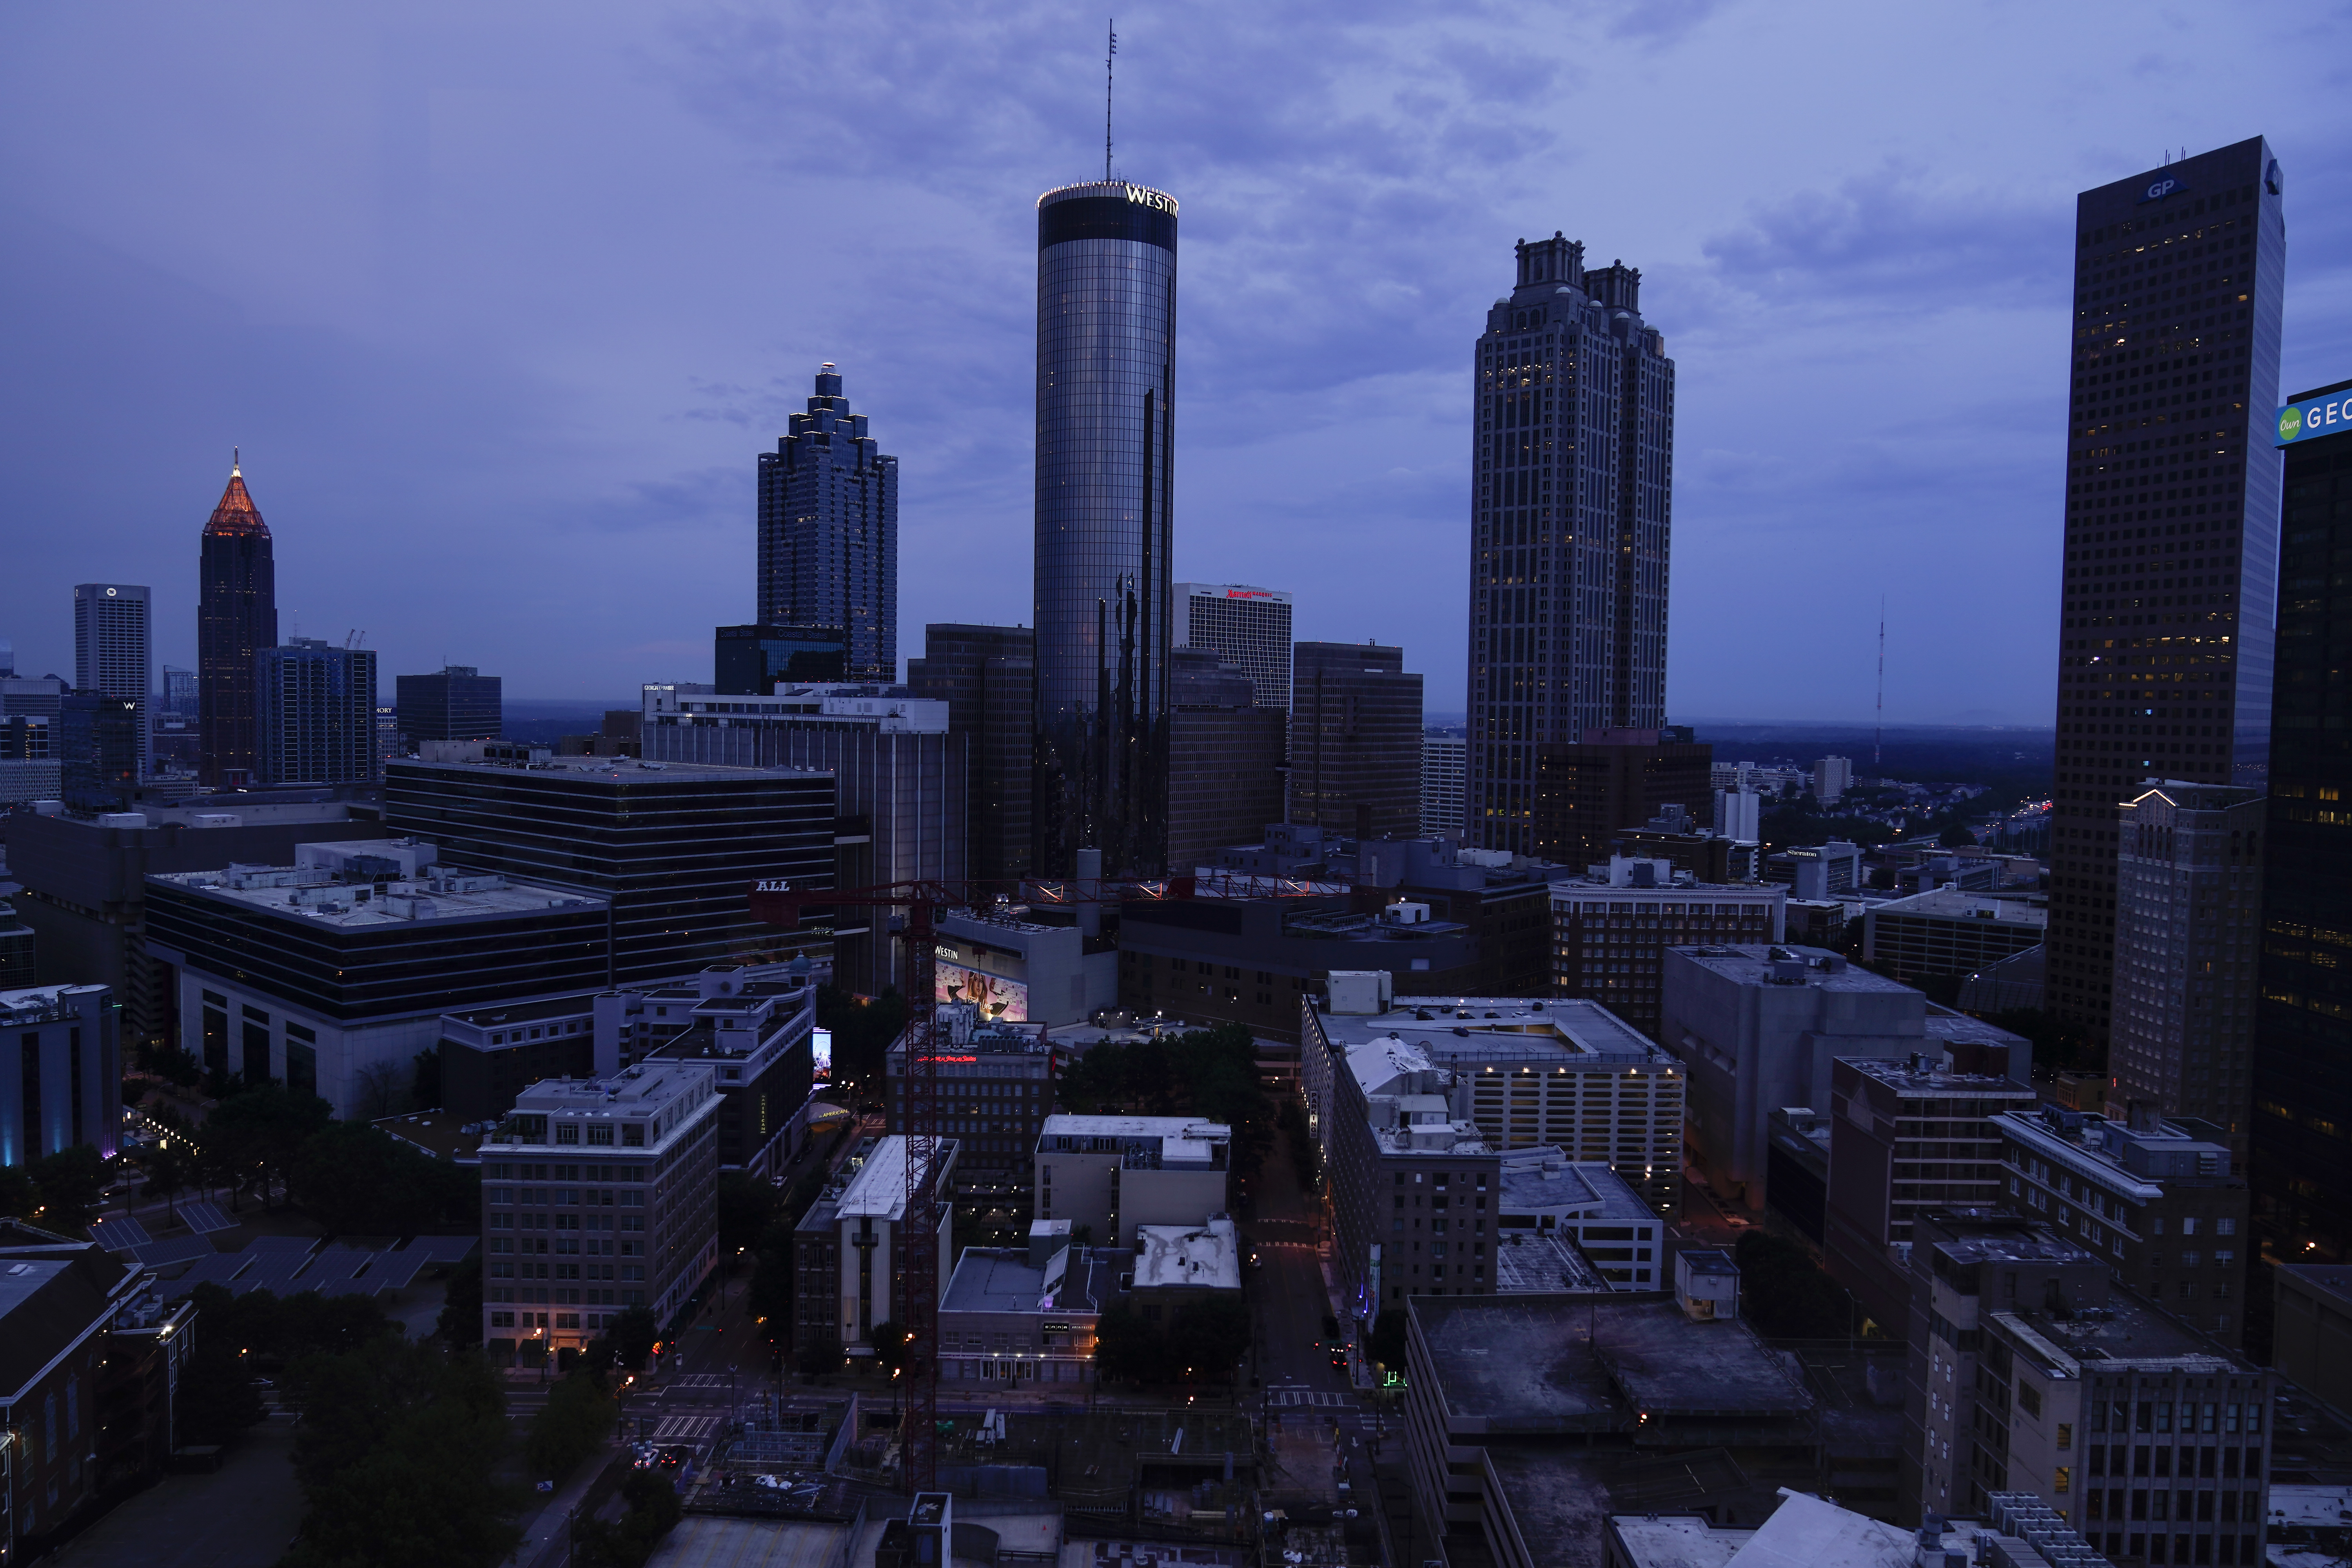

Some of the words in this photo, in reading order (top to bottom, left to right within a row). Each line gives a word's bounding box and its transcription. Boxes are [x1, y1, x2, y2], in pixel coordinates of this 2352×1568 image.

[2148, 180, 2174, 198] GP
[1125, 185, 1177, 218] WESTIN
[2280, 419, 2300, 431] Own
[1226, 589, 1252, 599] Marriott
[778, 629, 803, 638] Coastal
[807, 631, 828, 639] States
[756, 881, 790, 891] ALL
[935, 945, 958, 960] WESTIN
[823, 1109, 848, 1118] AMERICAN
